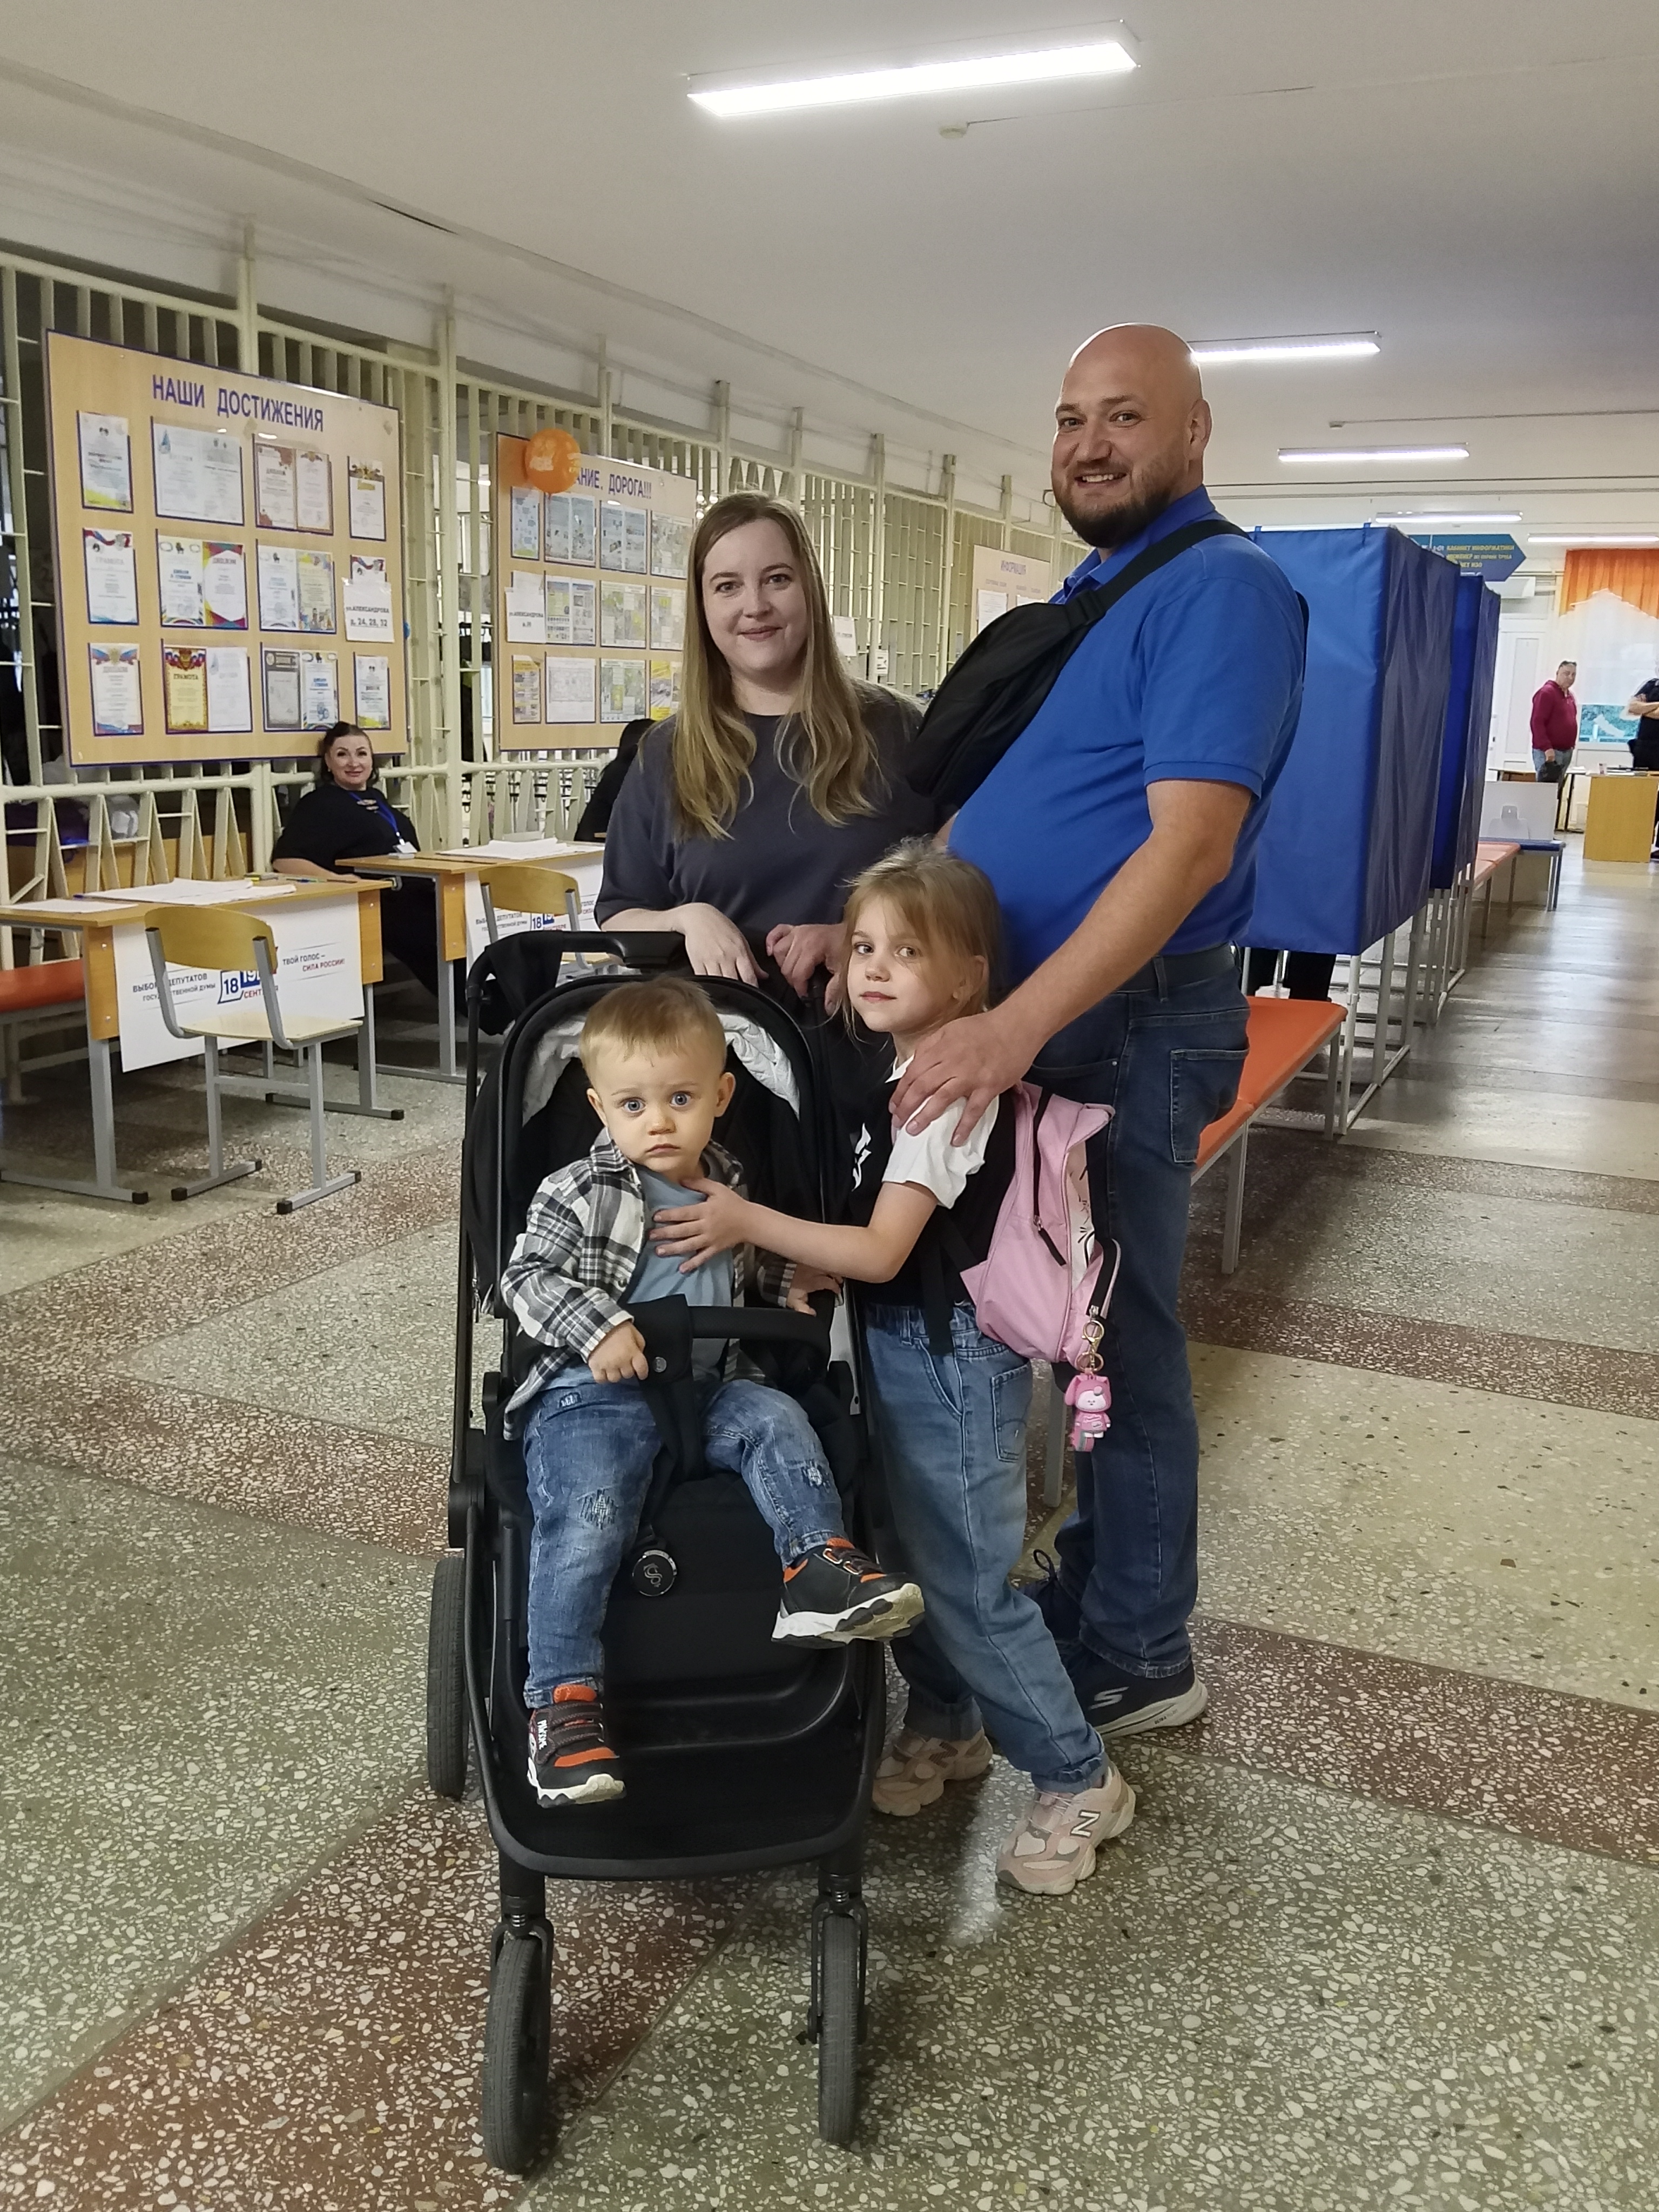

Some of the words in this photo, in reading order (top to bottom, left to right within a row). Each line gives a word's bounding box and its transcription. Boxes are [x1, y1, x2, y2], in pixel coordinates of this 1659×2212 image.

[152, 374, 205, 408] НАШИ
[217, 388, 323, 432] ДОСТИЖЕНИЯ
[608, 474, 652, 499] ДОРОГА!!!
[532, 916, 542, 929] 18
[282, 955, 299, 965] ТВОЙ
[300, 953, 320, 962] ГОЛОС
[302, 963, 319, 972] СИЛА
[132, 982, 157, 993] ВЫБО
[224, 977, 239, 995] 18
[1070, 1810, 1101, 1839] N
